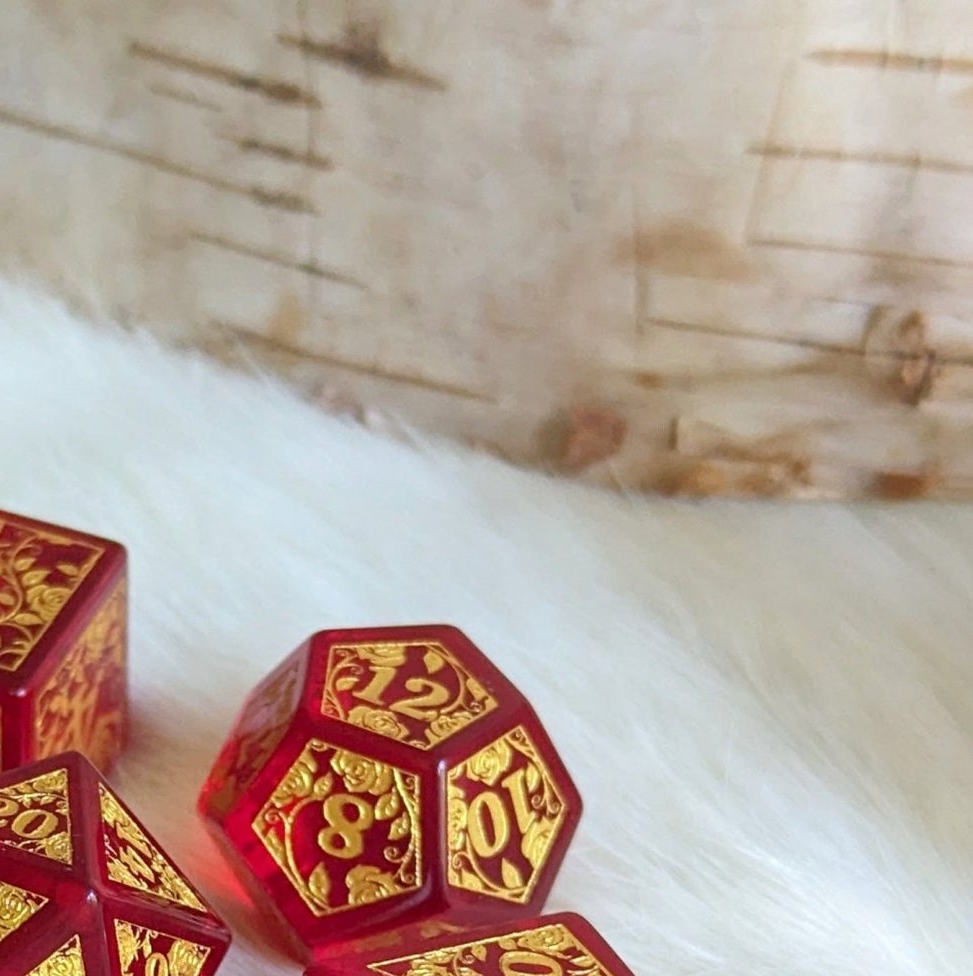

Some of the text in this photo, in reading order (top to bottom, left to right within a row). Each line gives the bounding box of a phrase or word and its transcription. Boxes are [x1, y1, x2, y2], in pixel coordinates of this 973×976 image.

[353, 665, 451, 720] 12
[317, 793, 374, 859] 8
[467, 768, 531, 858] 10
